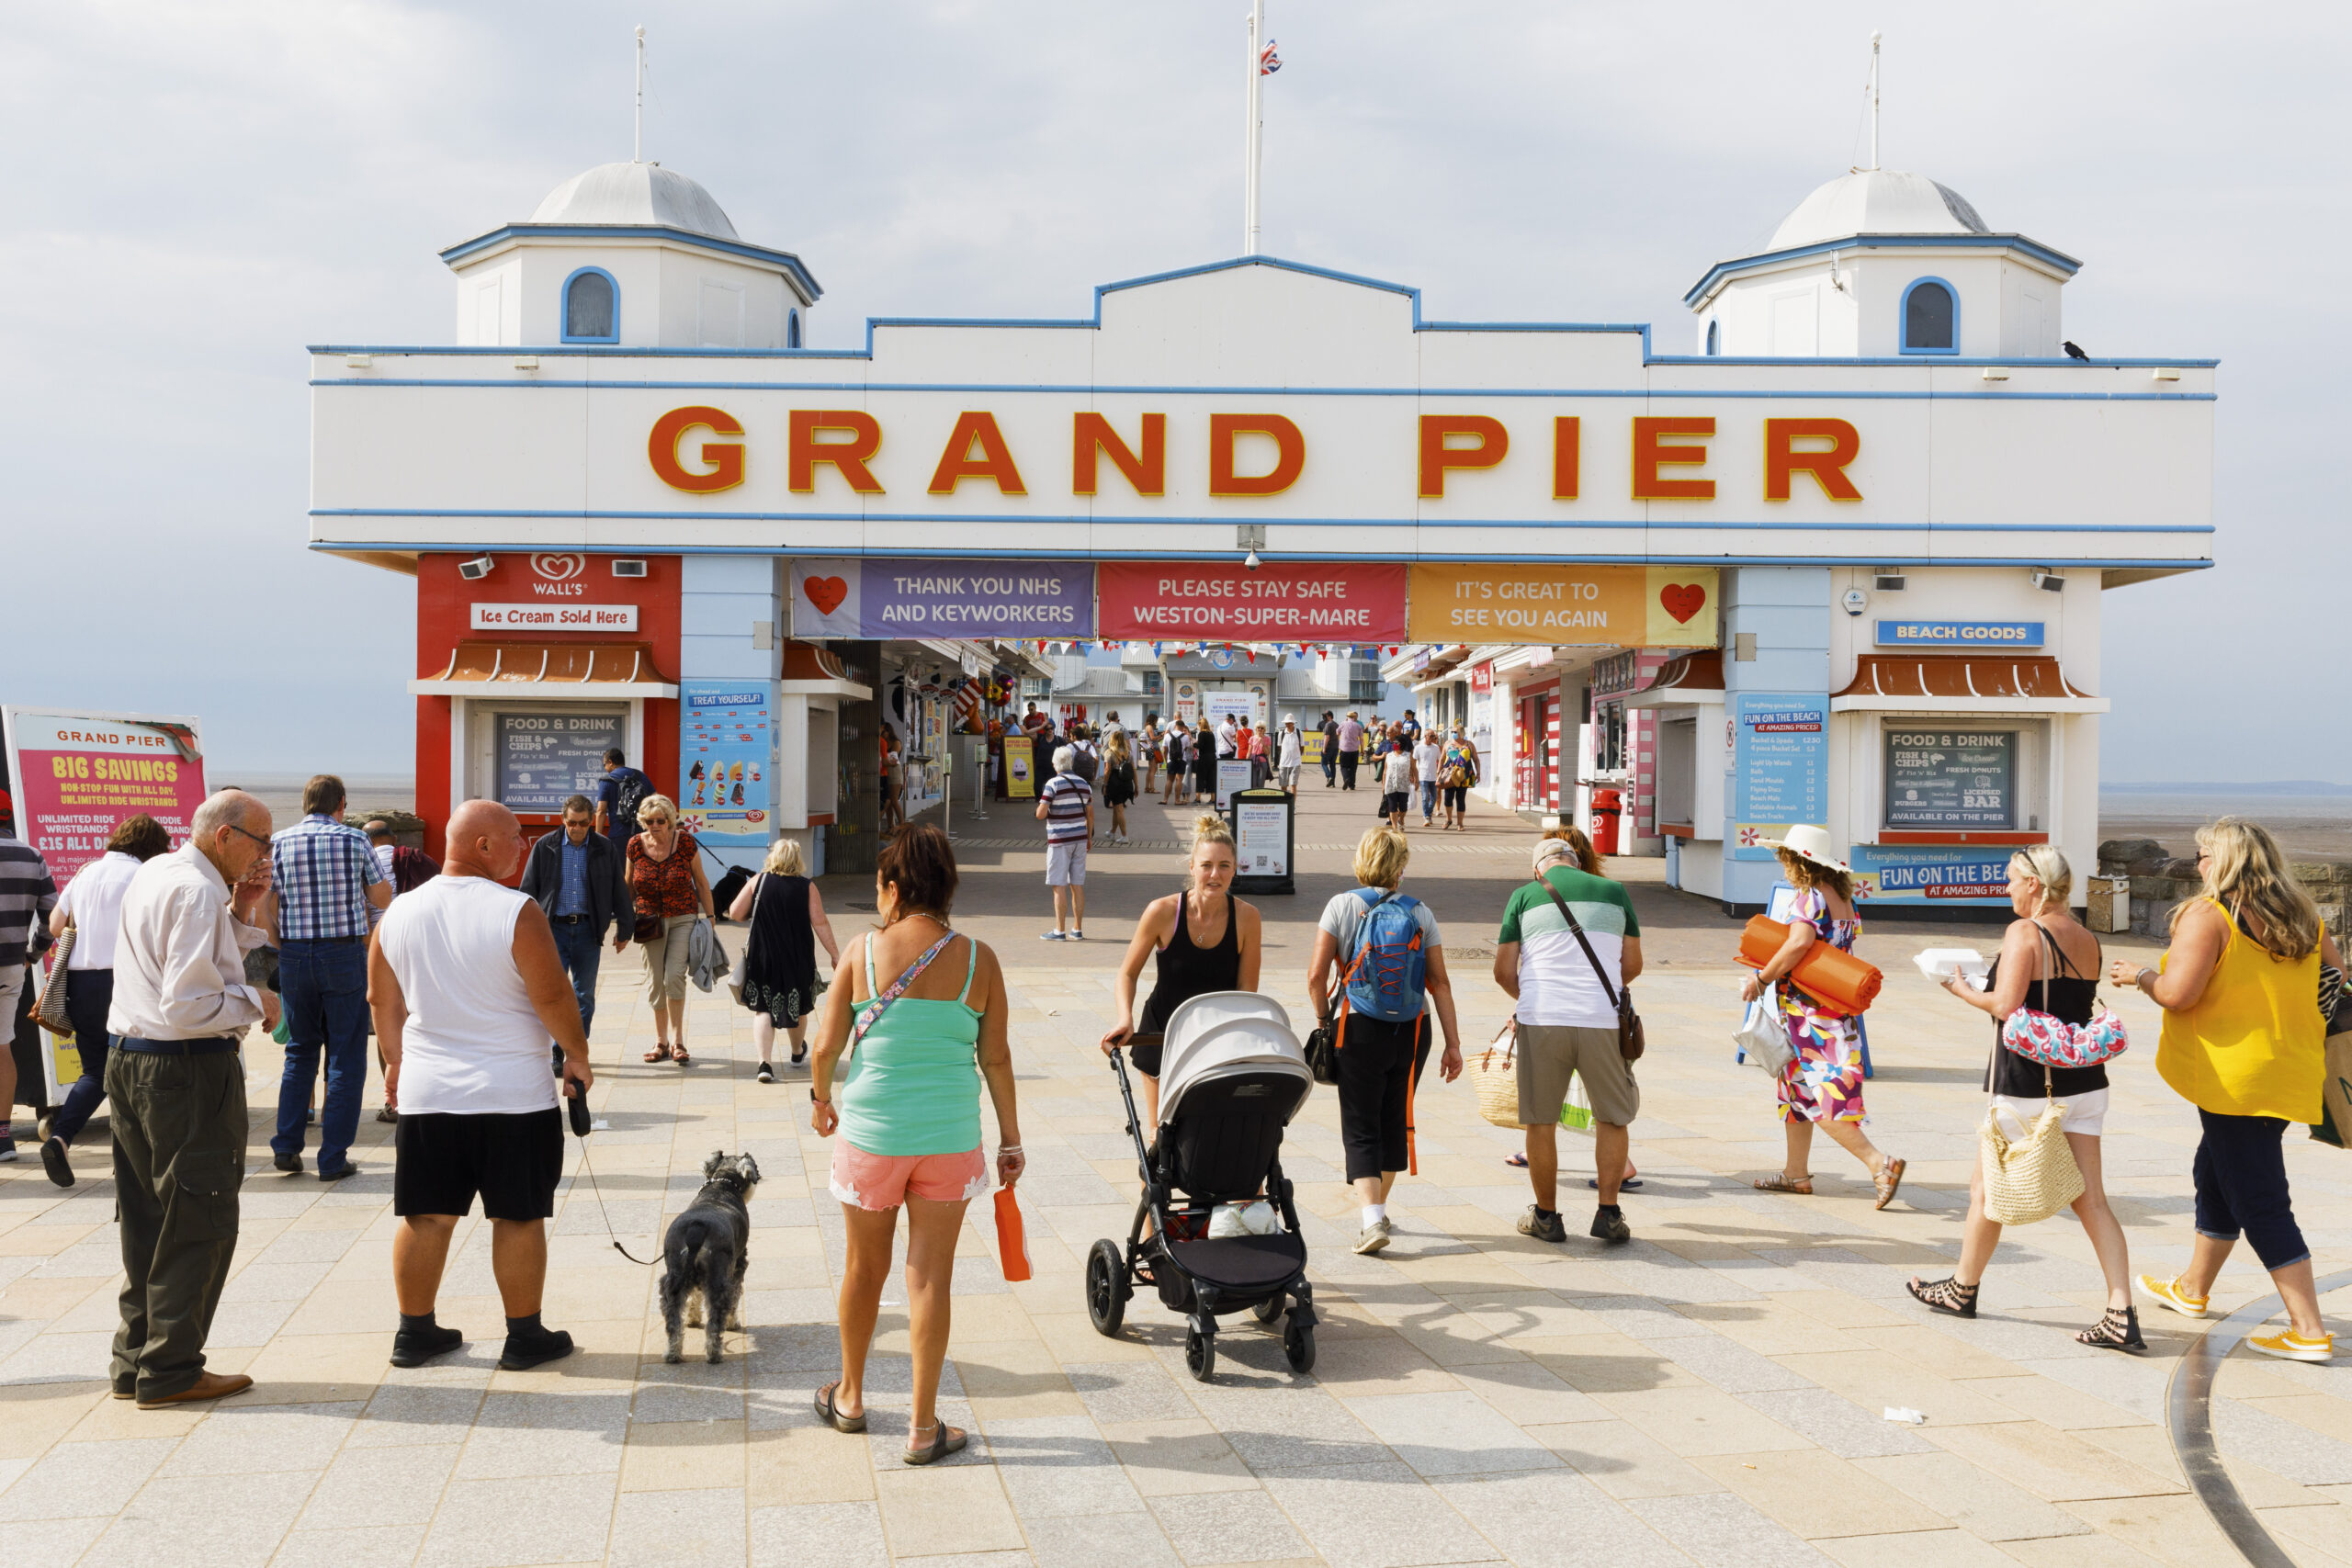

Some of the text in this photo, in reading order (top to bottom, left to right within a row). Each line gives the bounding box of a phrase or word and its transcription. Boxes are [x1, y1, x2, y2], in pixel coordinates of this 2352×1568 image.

[648, 406, 1863, 502] GRAND PIER
[533, 582, 582, 595] WALL'S
[893, 577, 1062, 596] THANK YOU NHS
[1159, 579, 1347, 599] PLEASE STAY SAFE
[1455, 581, 1599, 601] IT'S GREAT TO
[481, 609, 628, 625] Ice Cream Sold Here
[882, 604, 1074, 622] AND KEYWORKERS
[1134, 606, 1370, 626] WESTON-SUPER-MARE
[1451, 608, 1608, 628] SEE YOU AGAIN
[1895, 626, 2027, 640] BEACH GOODS
[693, 694, 761, 706] TREAT YOURSELF!
[1745, 711, 1820, 724] FUN ON THE BEACH
[505, 718, 616, 730] FOOD & DRINK
[57, 730, 166, 747] GRAND PIER
[508, 735, 542, 743] FISH &
[1892, 735, 2005, 747] FOOD & DRINK
[508, 742, 542, 751] CHIPS
[1894, 759, 1929, 767] CHIPS
[51, 756, 178, 783] BIG SAVINGS
[61, 783, 102, 793] NON-STOP
[103, 784, 119, 794] FUN
[120, 784, 141, 795] WITH
[143, 785, 157, 795] ALL
[575, 779, 599, 791] BA
[61, 795, 178, 807] UNLIMITED RIDE WRISTBANDS
[504, 795, 555, 804] AVAILABLE
[1962, 795, 2001, 808] BAR
[37, 814, 116, 824] UNLIMITED RIDE
[1962, 813, 1981, 821] THE
[45, 825, 109, 834] WRISTBANDS
[39, 836, 110, 851] £15 ALL DA
[67, 856, 85, 864] major
[1866, 852, 1962, 863] Everything you need for
[1881, 867, 1914, 886] FUN
[1917, 866, 1945, 885] ON
[1945, 865, 1977, 884] THE
[1929, 886, 1941, 896] AT
[1942, 886, 1987, 896] AMAZING
